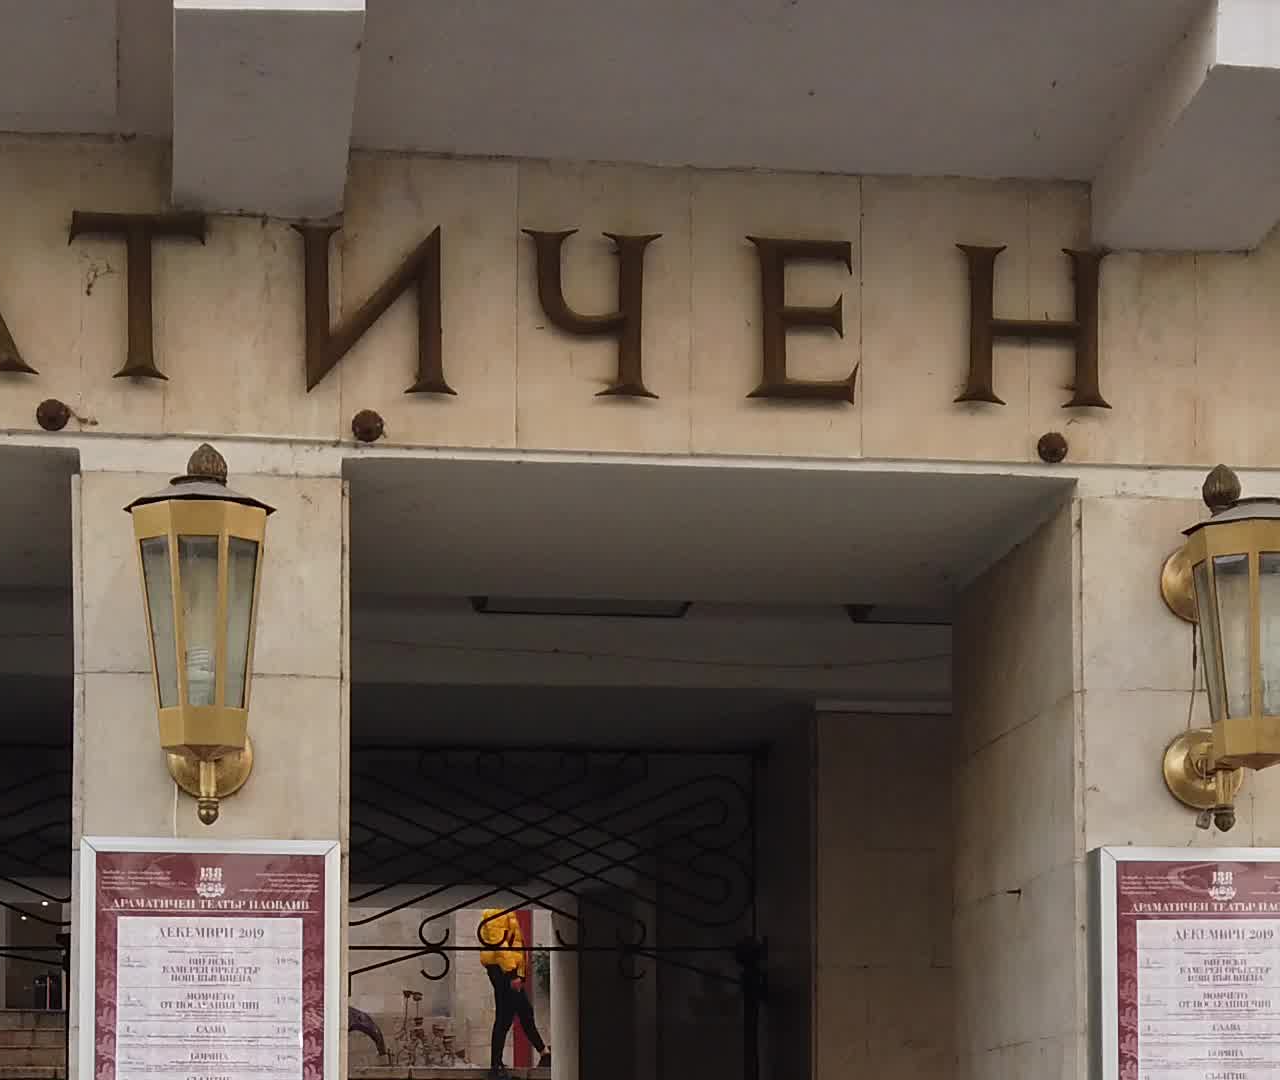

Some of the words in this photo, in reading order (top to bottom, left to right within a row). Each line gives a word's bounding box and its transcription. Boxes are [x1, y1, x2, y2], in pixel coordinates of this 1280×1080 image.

[112, 898, 195, 909] ДРАМАТИЧЕН
[199, 899, 246, 910] ТЕАТЪР
[249, 900, 310, 910] ПЛОВДИВ
[1131, 902, 1209, 912] ДРАМАТИЧЕН
[1213, 902, 1258, 912] ТЕАТЪР
[159, 927, 234, 939] ДЕКЕМВРИ
[238, 927, 265, 939] 2019
[1248, 928, 1274, 940] 2019
